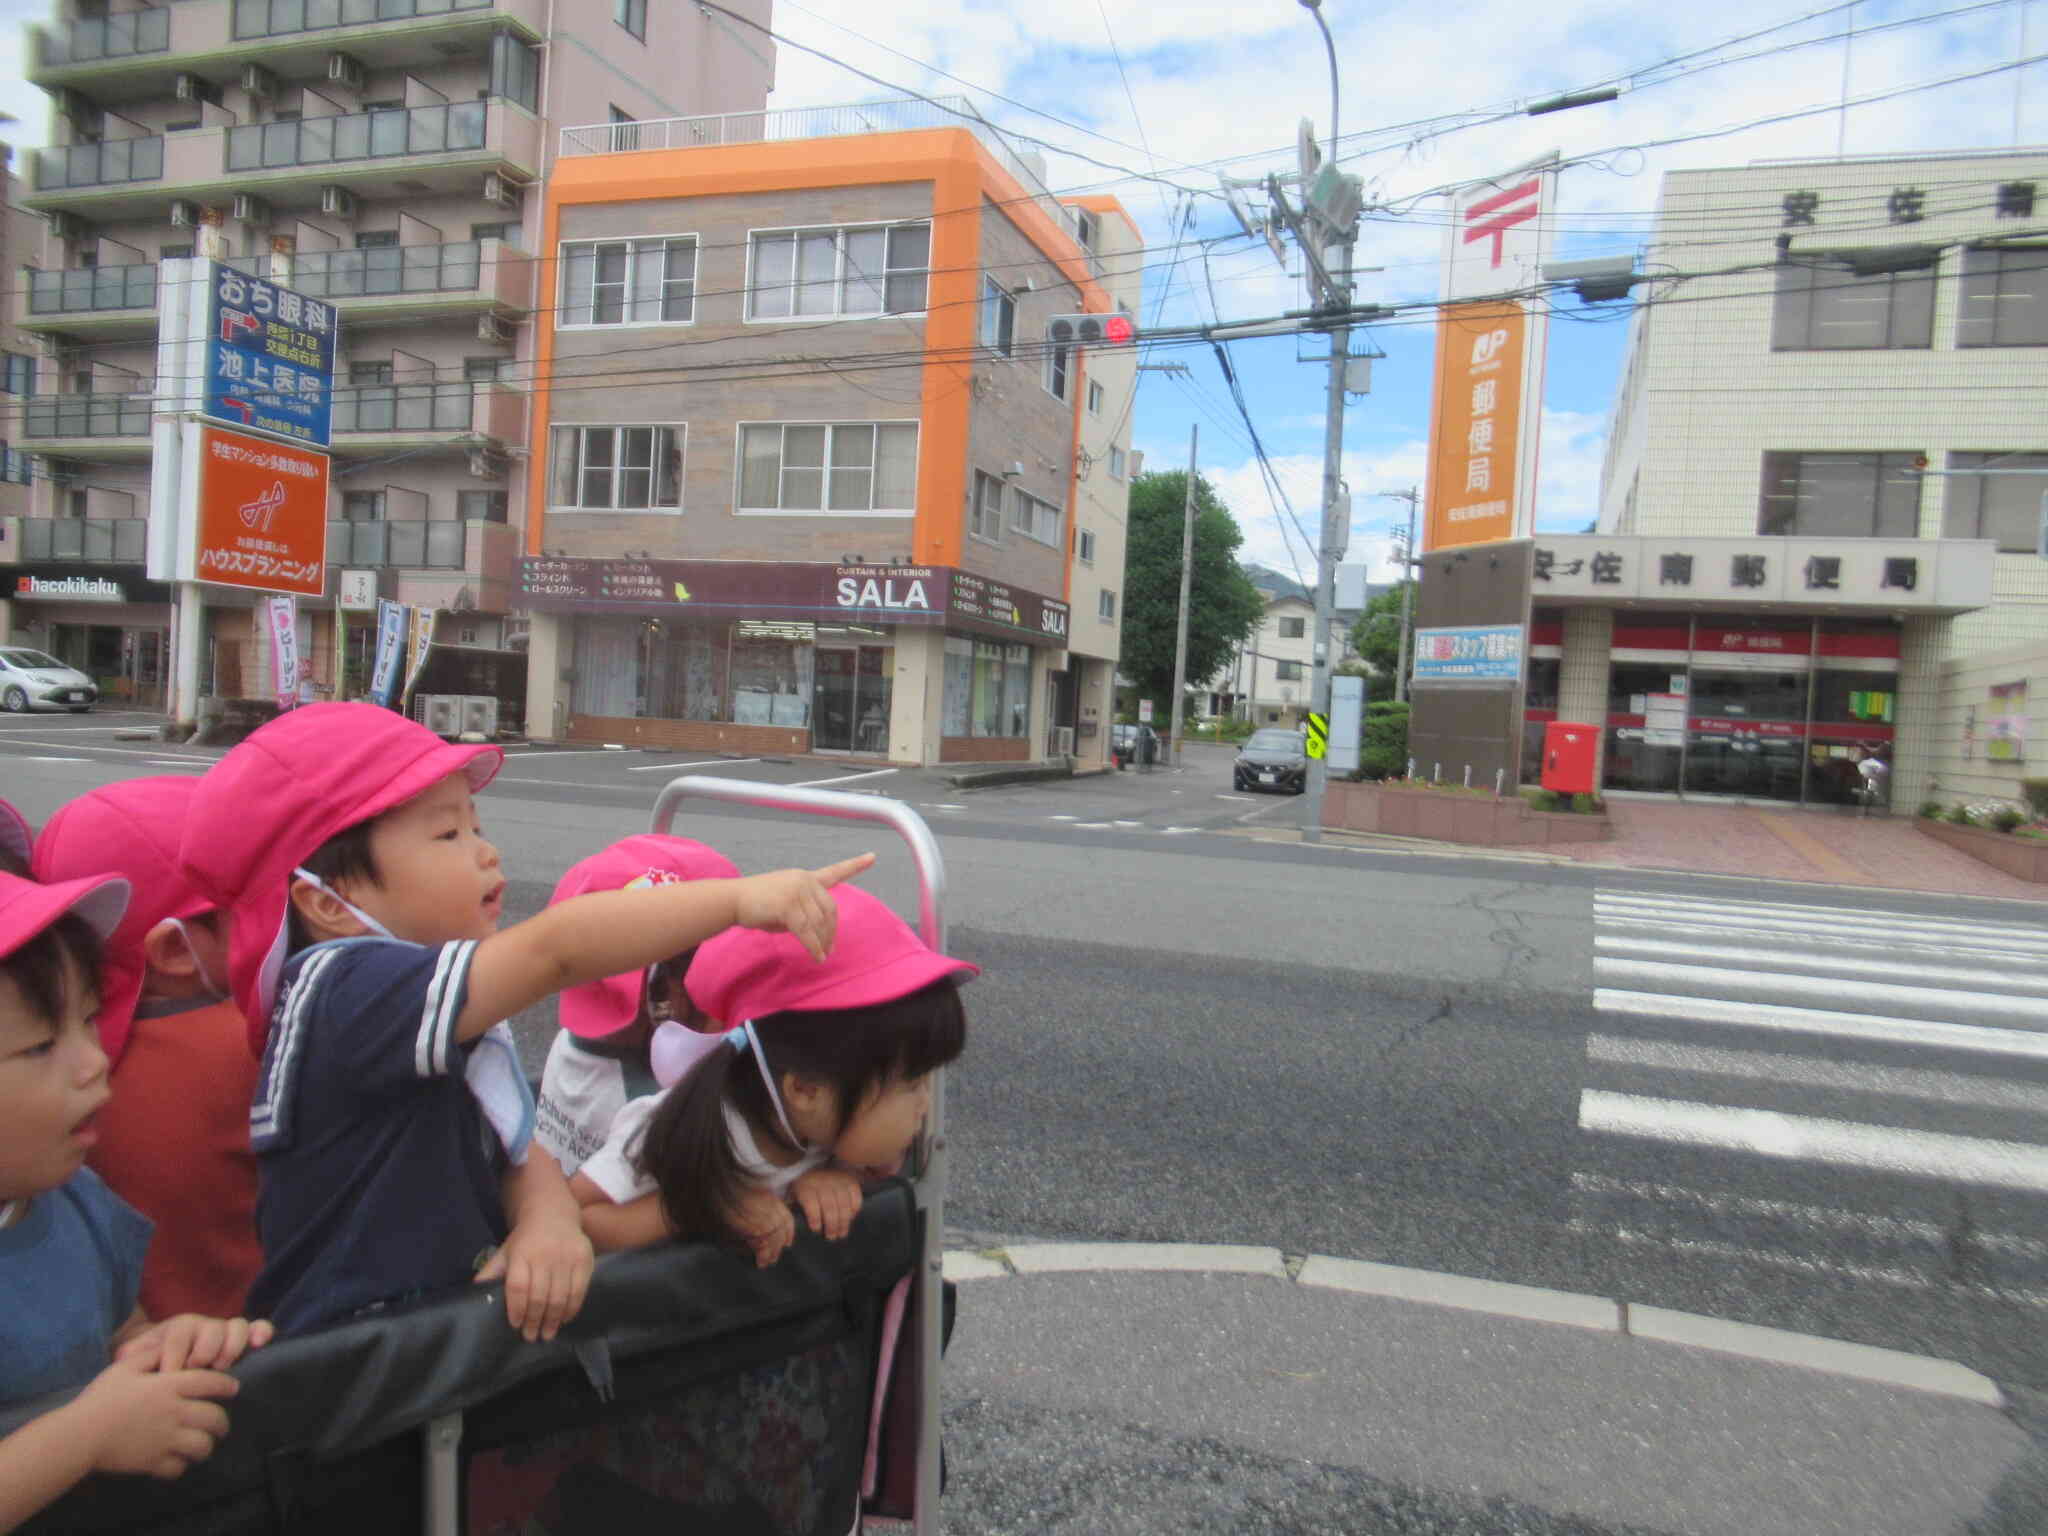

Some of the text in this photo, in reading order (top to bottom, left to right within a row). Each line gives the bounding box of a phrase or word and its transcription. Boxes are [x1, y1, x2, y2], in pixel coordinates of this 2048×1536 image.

[219, 269, 329, 334] おち眼科
[218, 347, 321, 404] 池上医院
[1466, 379, 1496, 493] 郵便局
[200, 548, 320, 582] ハウスプランニング
[888, 568, 931, 577] INTERIOR
[31, 576, 117, 595] hacokikaku
[836, 578, 929, 609] SALA
[1041, 608, 1065, 634] SALA
